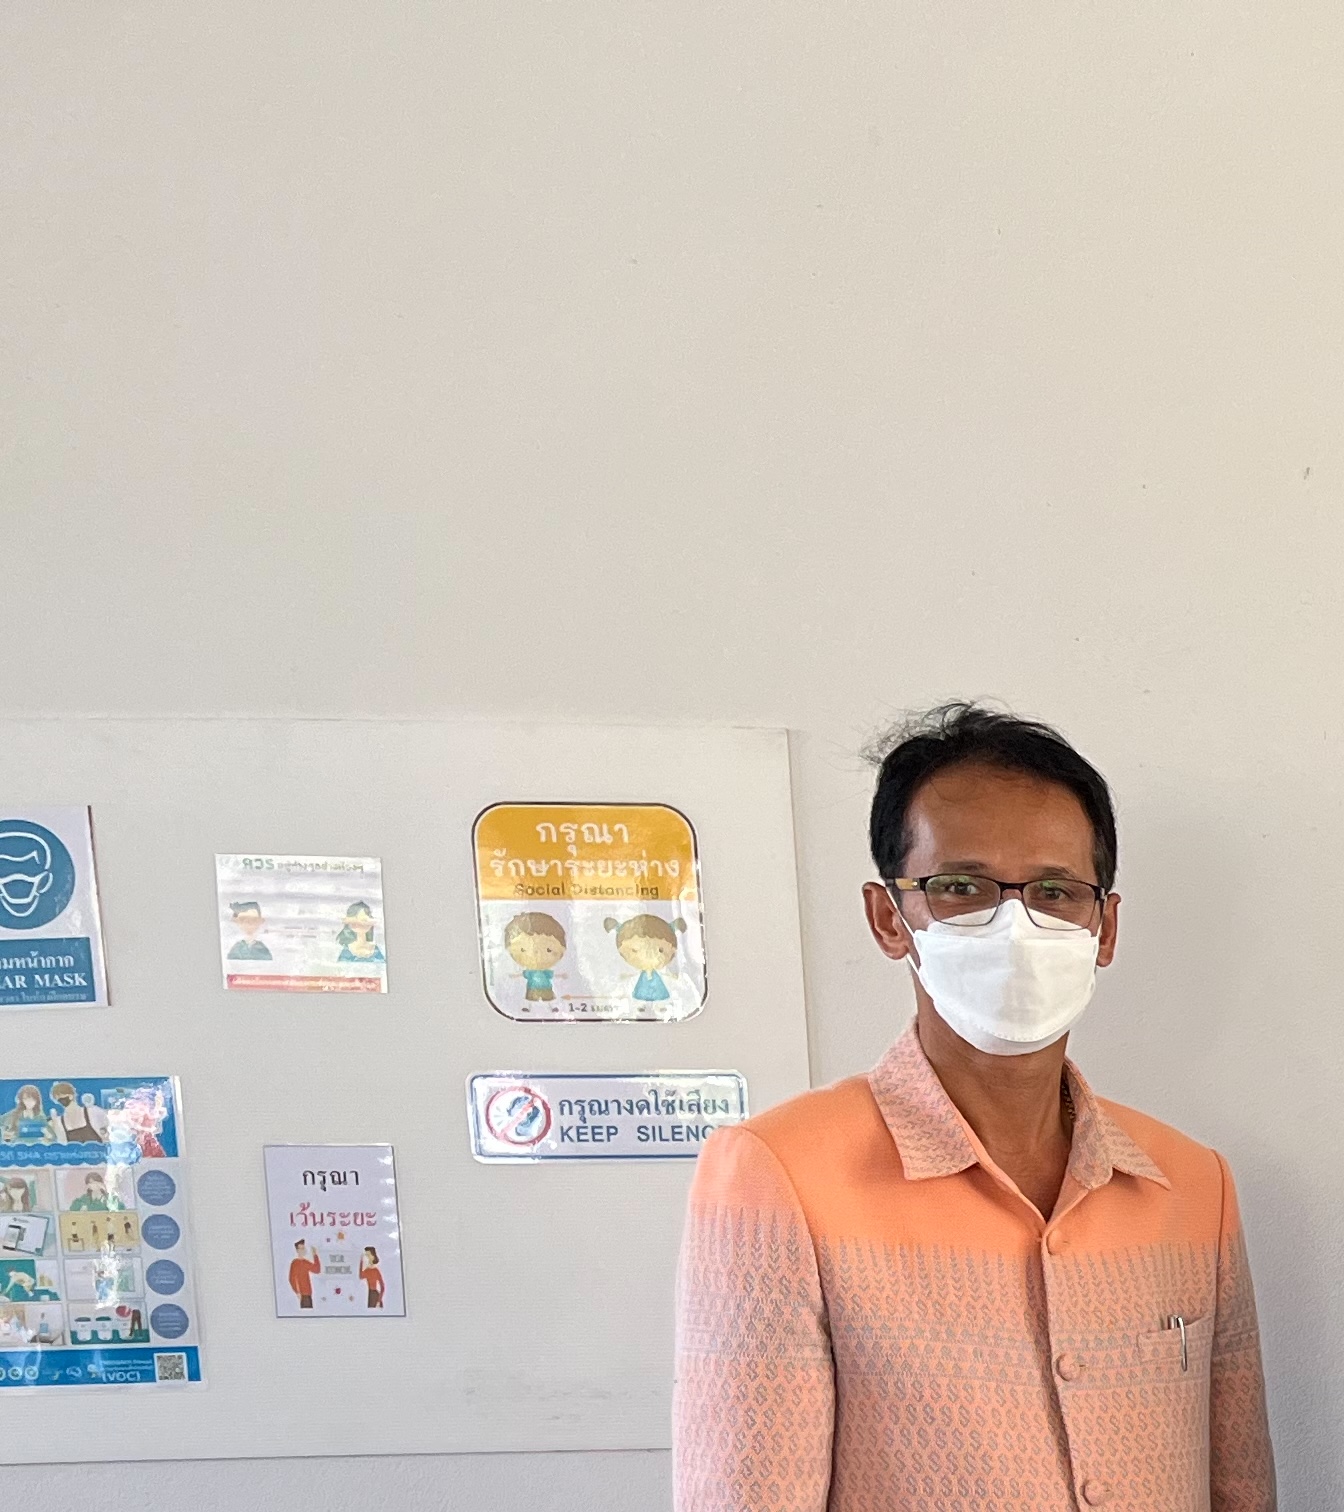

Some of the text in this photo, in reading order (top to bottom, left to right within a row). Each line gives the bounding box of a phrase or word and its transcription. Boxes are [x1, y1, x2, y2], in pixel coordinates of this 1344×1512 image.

[535, 822, 629, 856] กรุณา
[489, 849, 681, 878] รักษาระยะห่าง
[513, 882, 659, 899] Social Distancing
[34, 972, 88, 989] MASK
[558, 1089, 730, 1124] กรุณางดใช้เสียง
[560, 1125, 722, 1143] KEEP SILENC
[302, 1170, 360, 1192] กรุณา
[290, 1202, 377, 1227] เว้นระยะ
